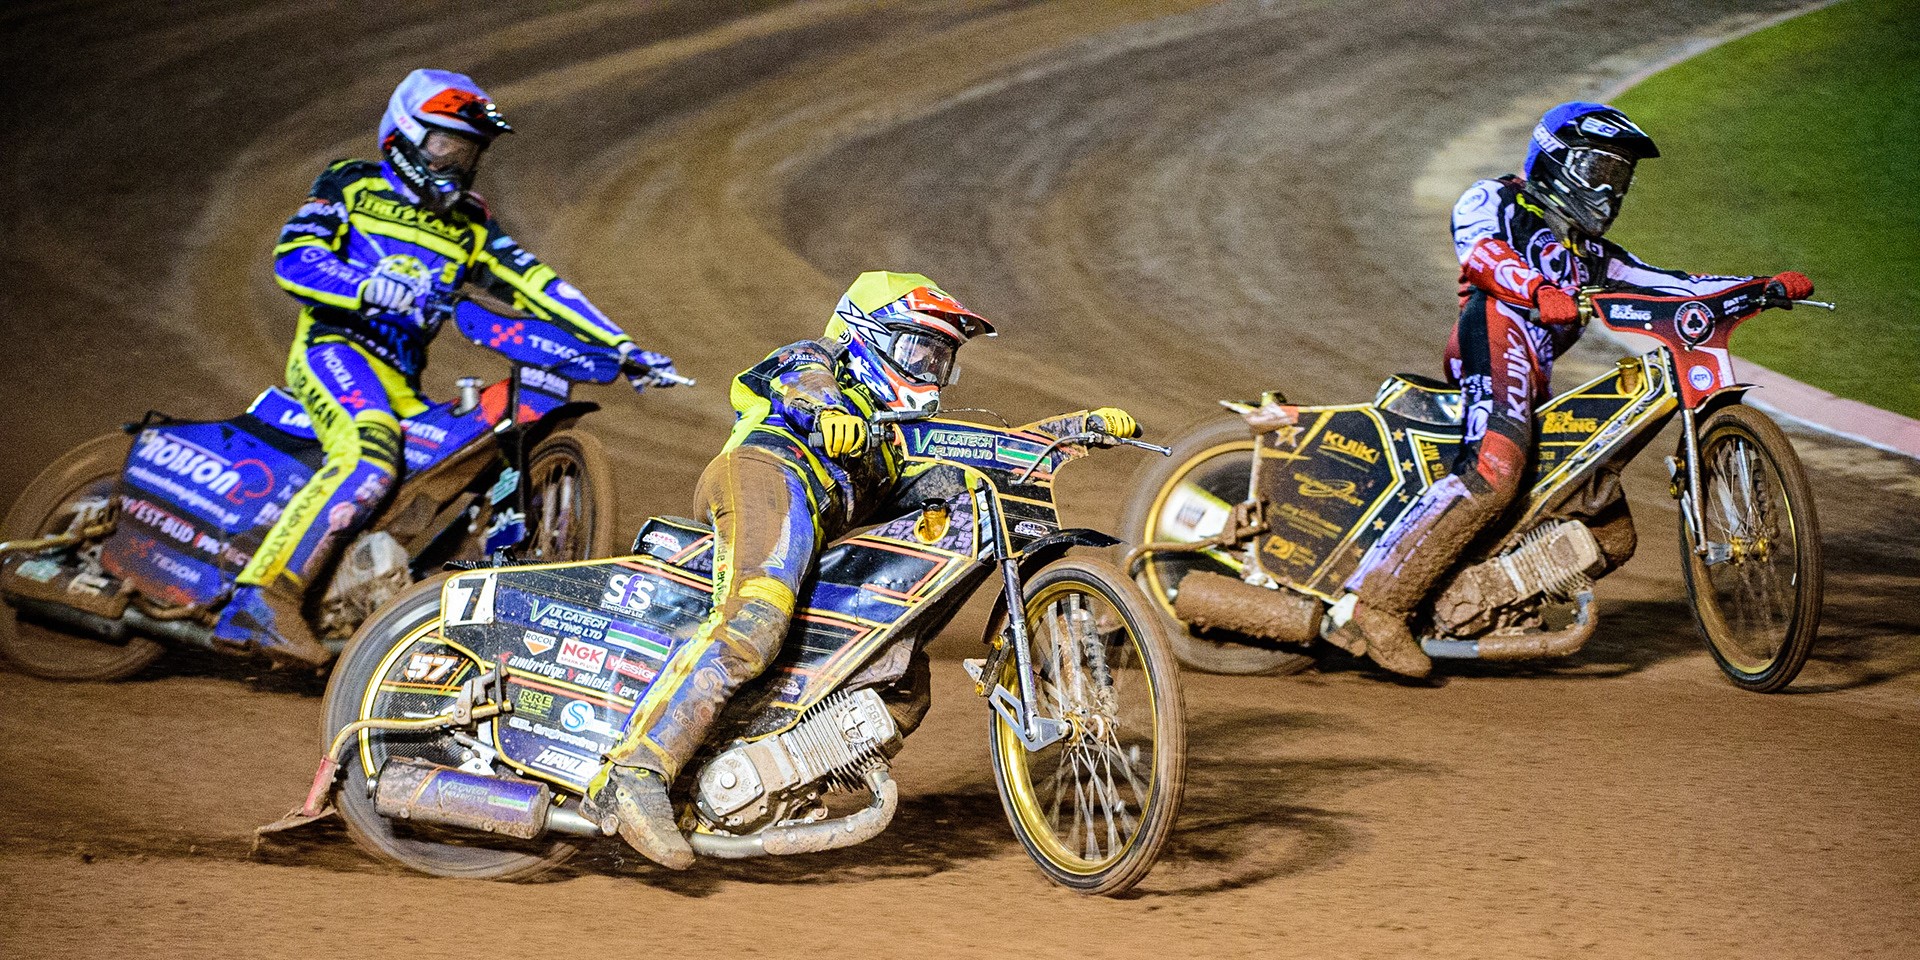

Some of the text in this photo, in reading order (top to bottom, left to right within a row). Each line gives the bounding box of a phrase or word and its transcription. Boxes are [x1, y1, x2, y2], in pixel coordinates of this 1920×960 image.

[1609, 310, 1652, 321] RACING
[528, 334, 596, 373] TEXOM
[322, 346, 356, 391] TEXOM
[1542, 419, 1598, 434] RACING
[914, 428, 995, 453] VULCATECH
[927, 444, 994, 460] BELTING LTD
[137, 436, 241, 495] ROBSON
[457, 577, 487, 622] 7
[601, 602, 645, 618] Electrical Ltd
[530, 599, 609, 629] VULCATECH
[525, 633, 555, 646] ROCOL
[540, 618, 603, 640] BELTING LTD
[562, 643, 604, 665] NGK
[407, 652, 457, 682] 57
[498, 651, 566, 679] Cambridge
[567, 669, 612, 691] Vehicle
[519, 688, 553, 707] RRE
